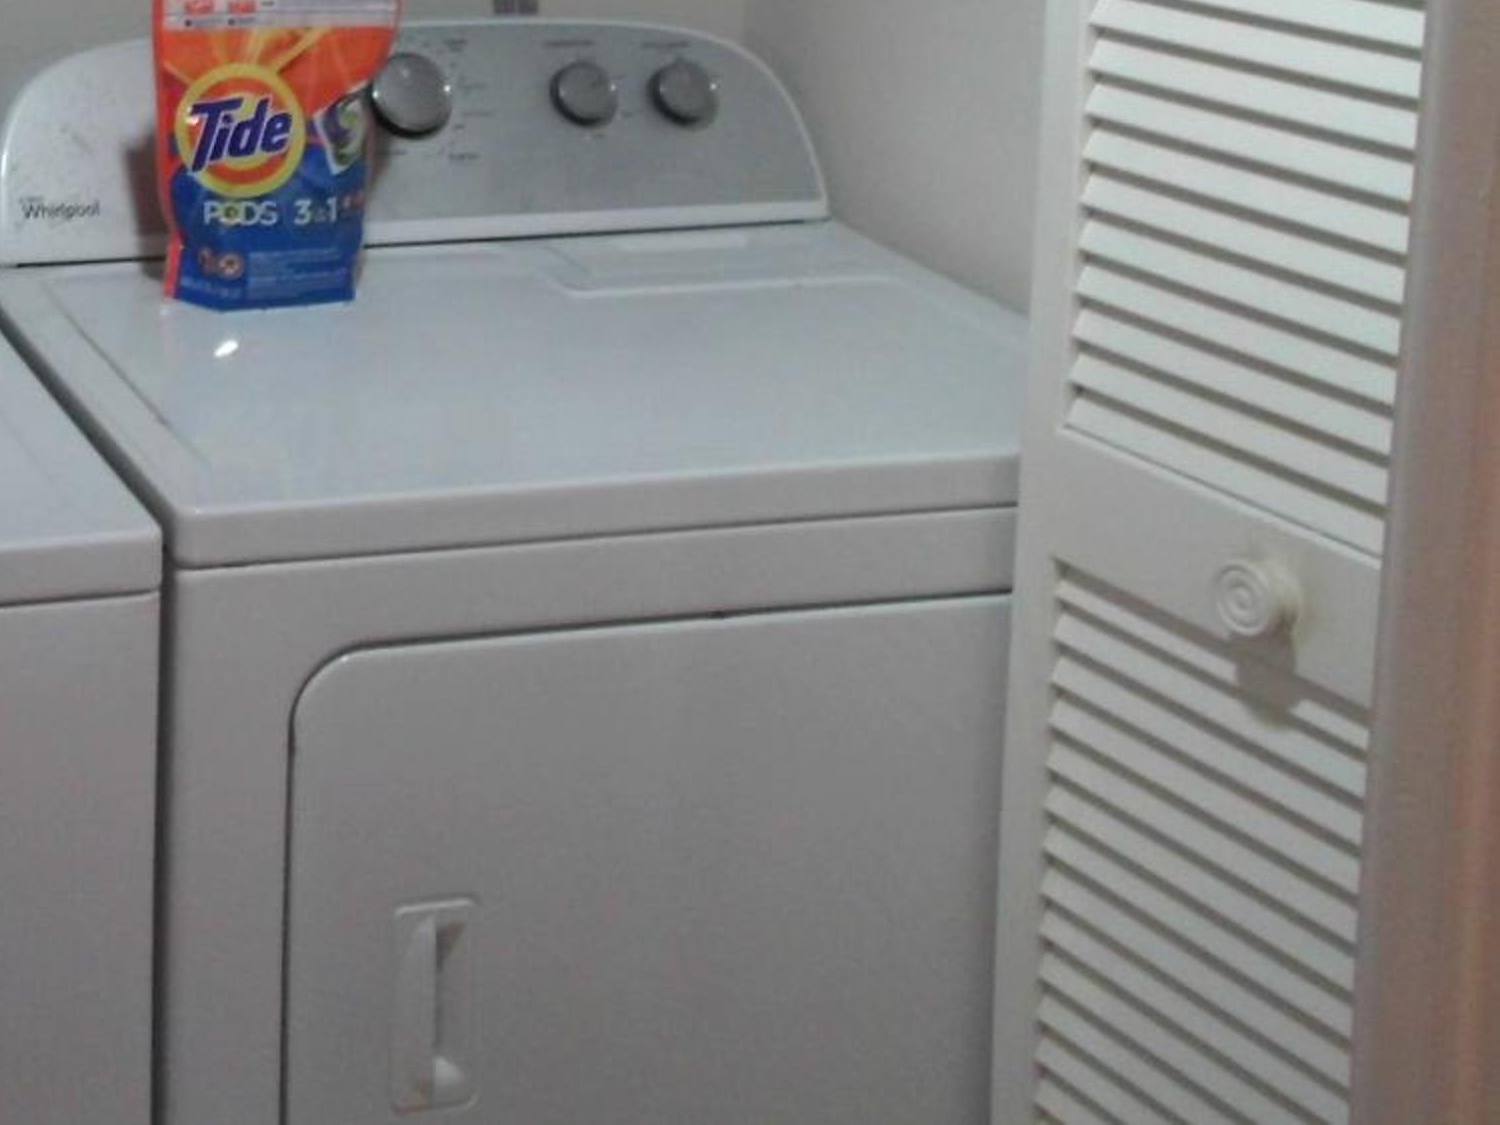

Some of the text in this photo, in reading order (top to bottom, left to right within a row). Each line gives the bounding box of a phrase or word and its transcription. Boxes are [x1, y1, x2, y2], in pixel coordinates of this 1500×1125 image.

[190, 96, 293, 172] Tide
[21, 200, 101, 220] Whirlpool
[203, 200, 278, 225] PODS
